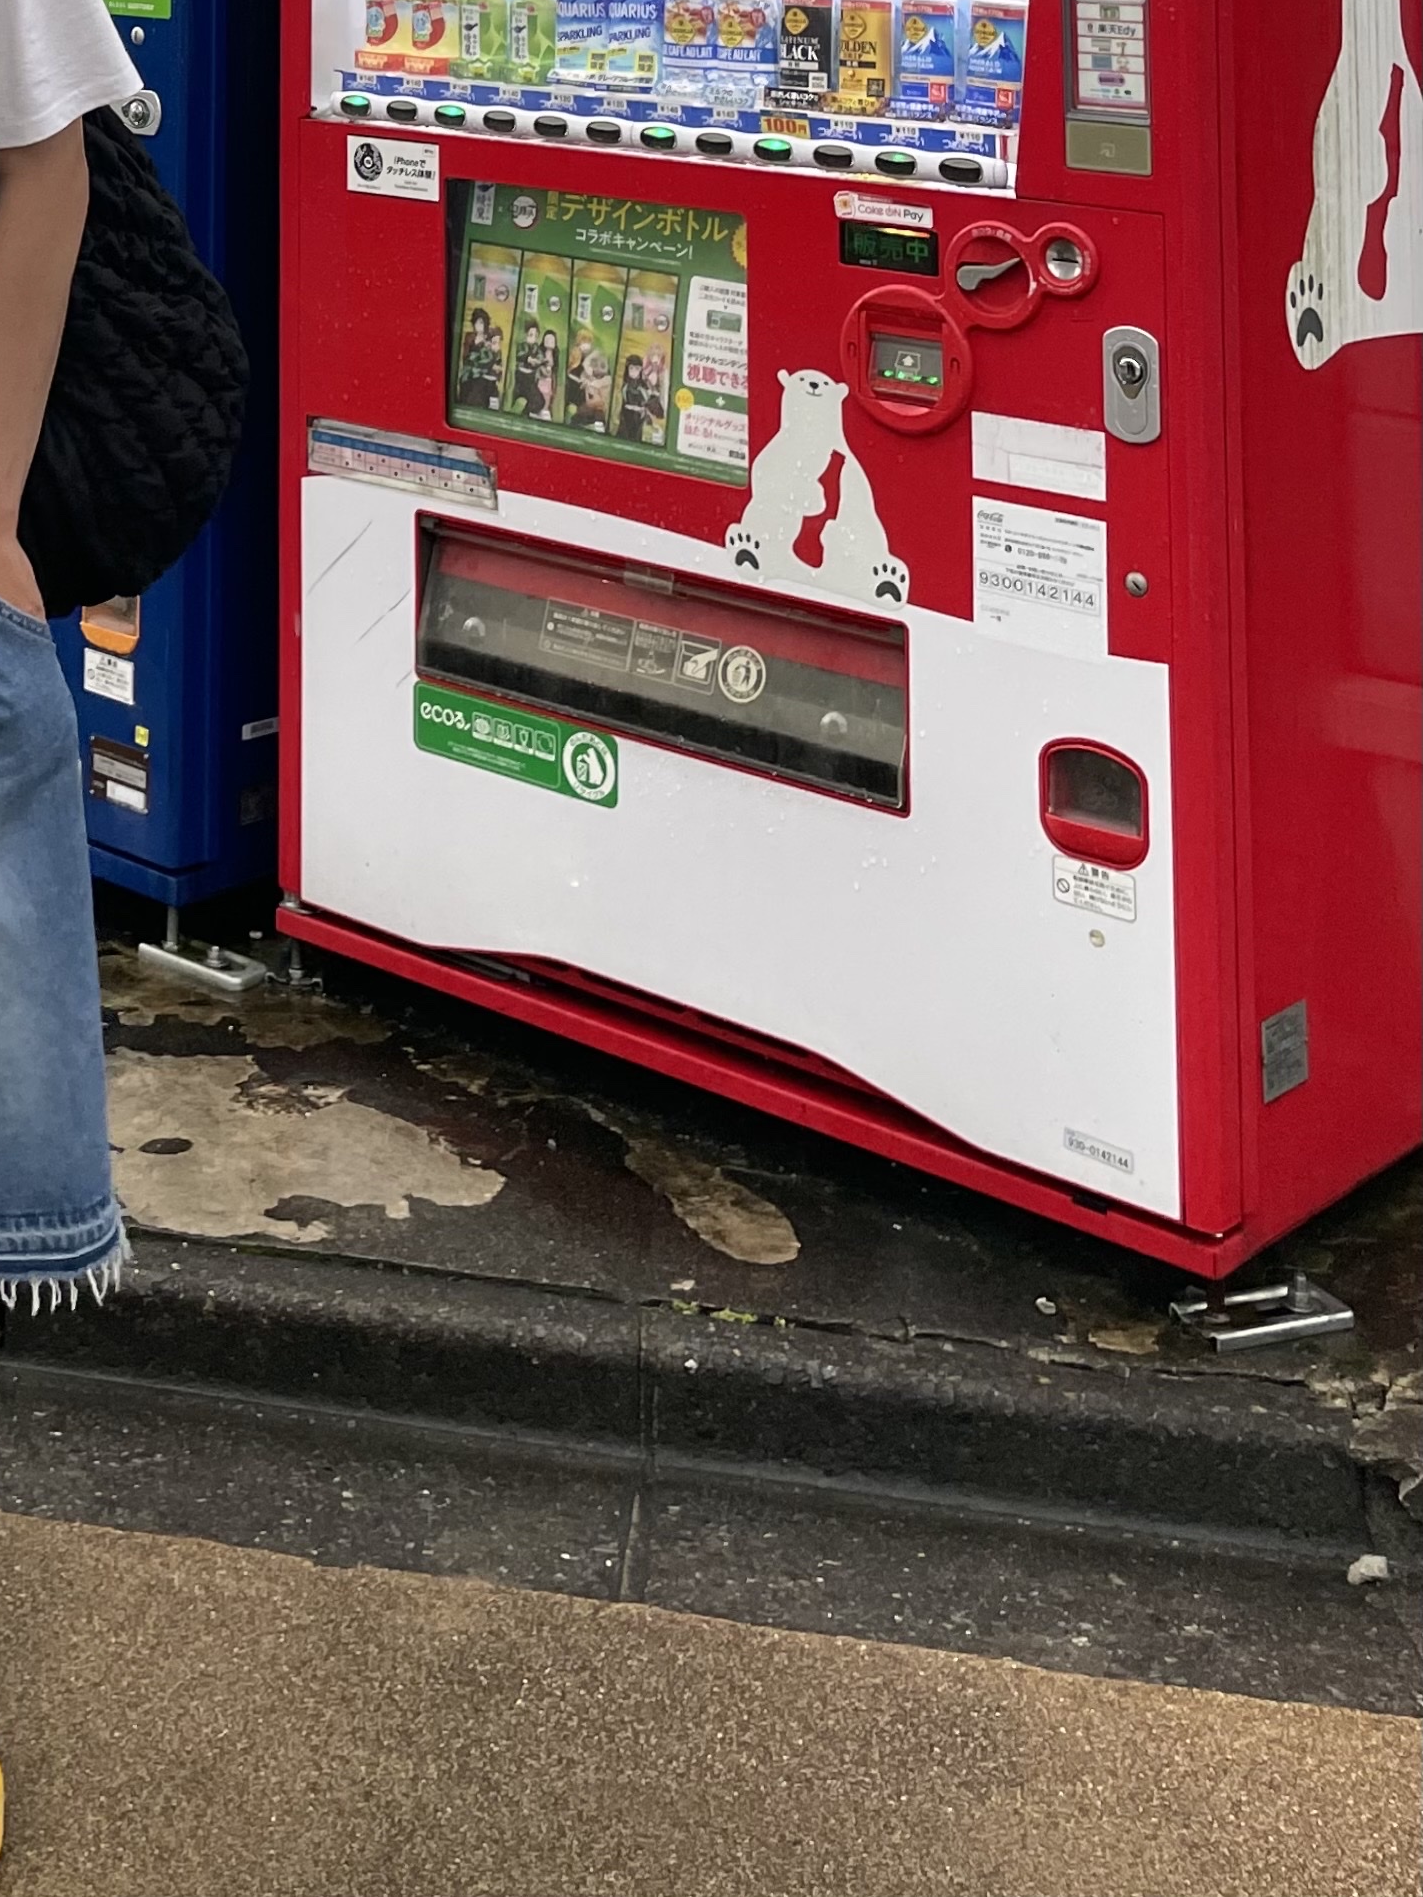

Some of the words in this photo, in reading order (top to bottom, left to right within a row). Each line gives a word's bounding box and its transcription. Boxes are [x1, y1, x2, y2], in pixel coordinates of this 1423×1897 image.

[763, 118, 807, 135] 100円
[834, 121, 854, 129] ¥110
[896, 126, 916, 135] ¥110
[960, 132, 980, 141] ¥110
[562, 193, 729, 242] デザインボトル
[858, 204, 884, 216] Coke
[903, 209, 923, 223] Pay
[575, 227, 693, 260] コラボキャンペーン!
[979, 571, 1095, 607] 9300142144
